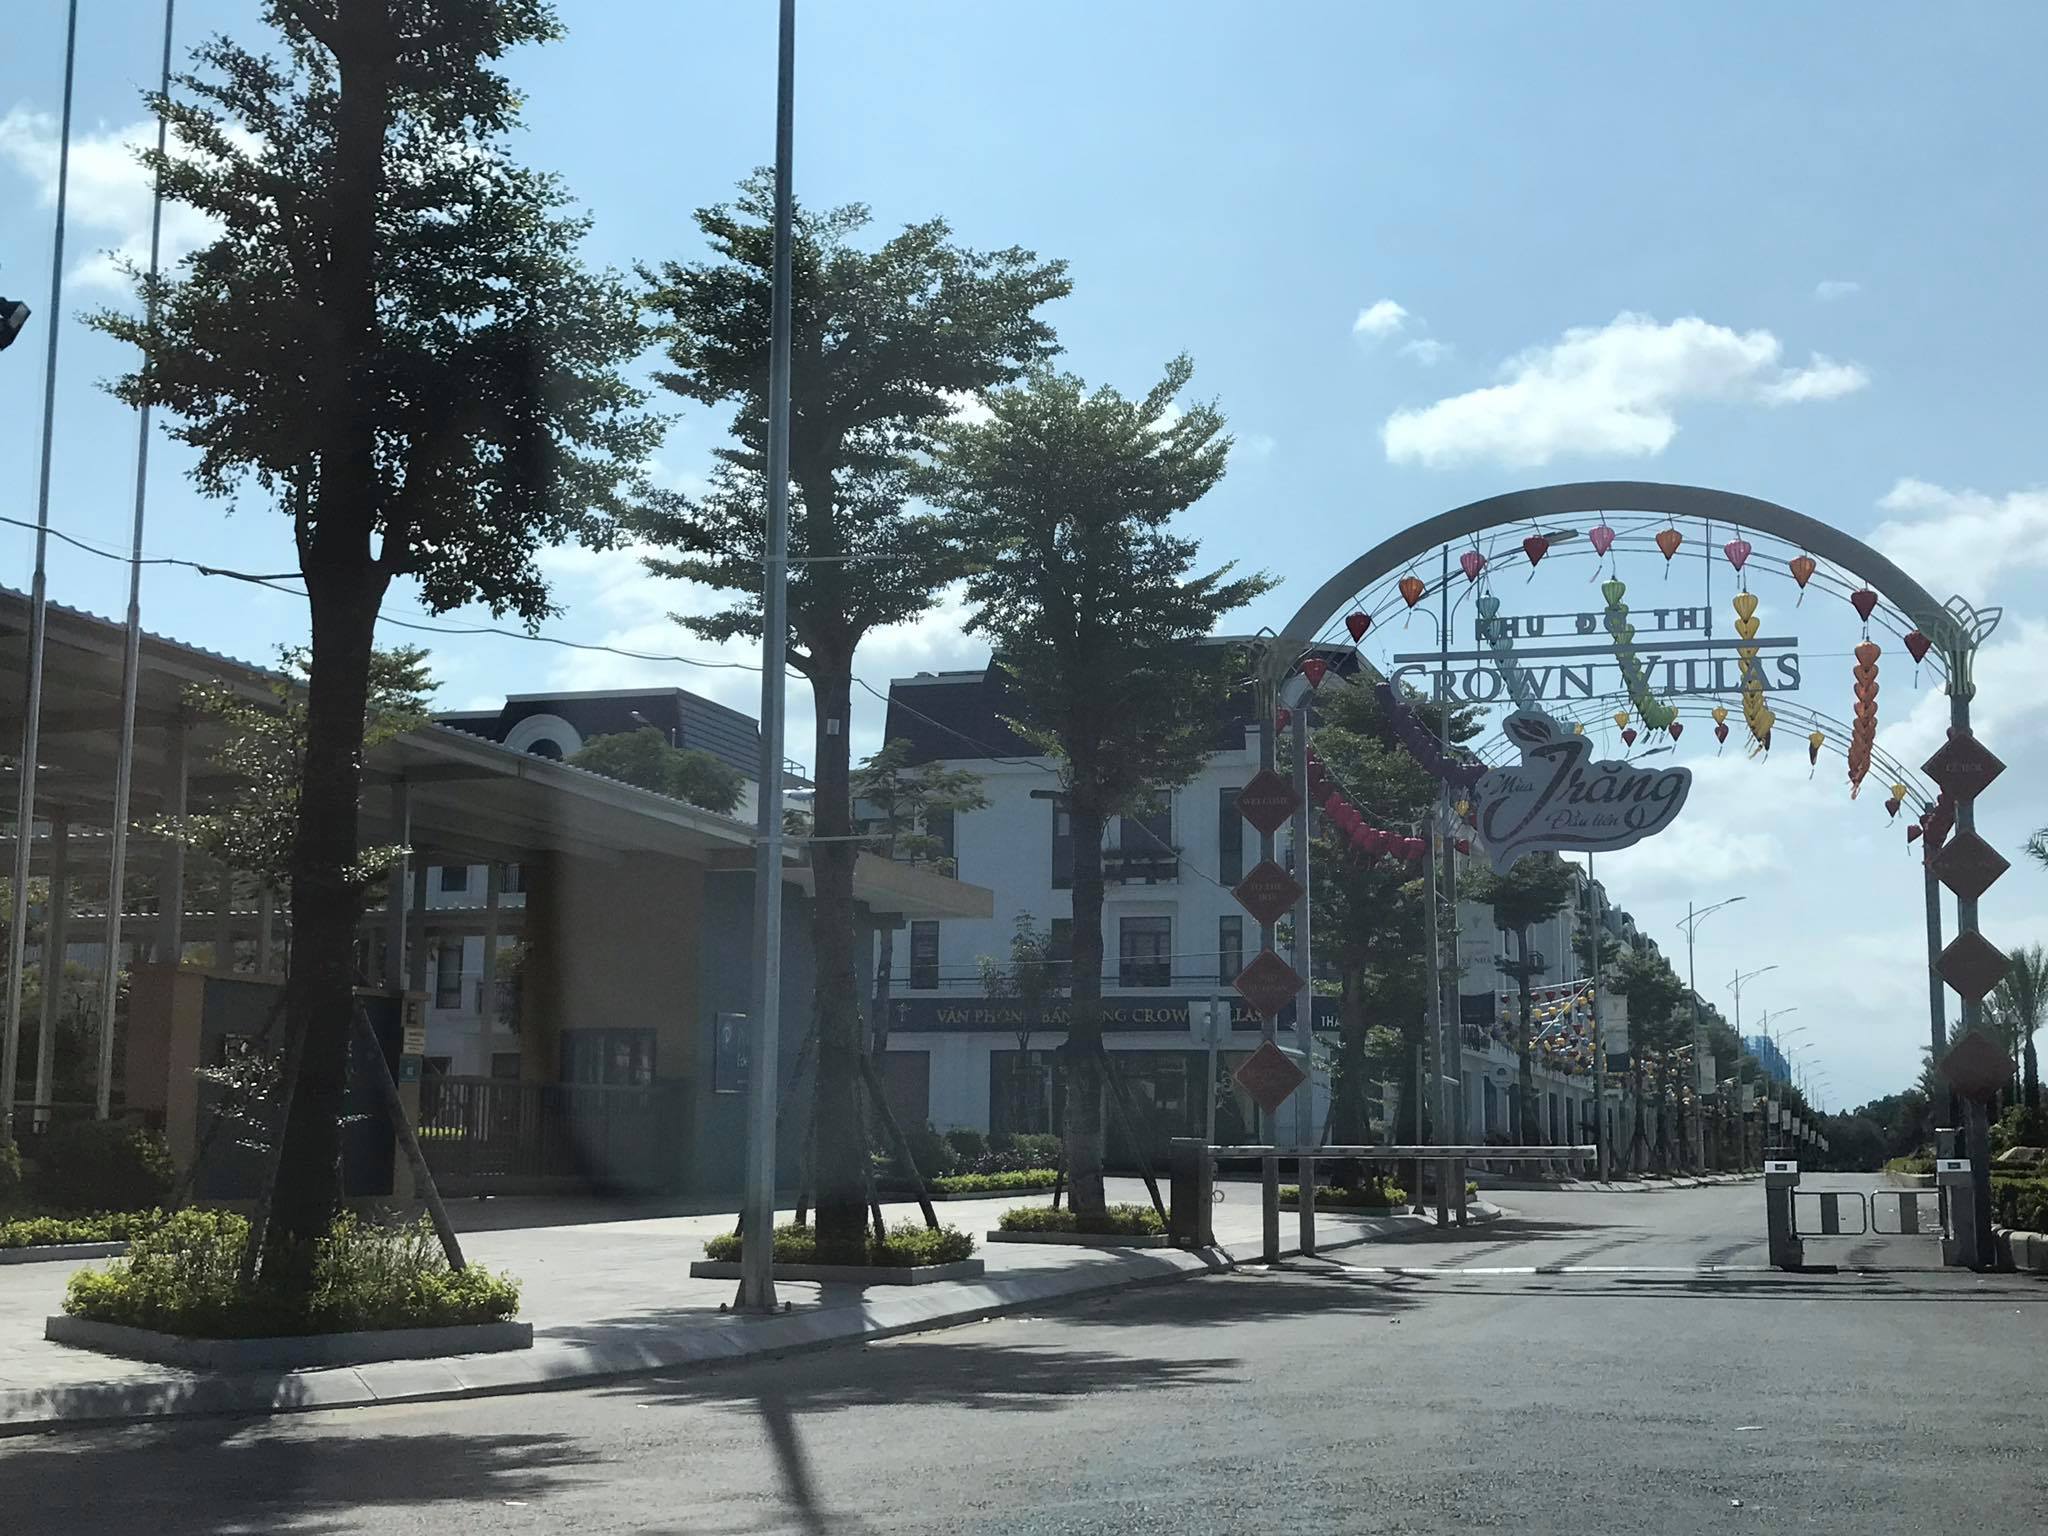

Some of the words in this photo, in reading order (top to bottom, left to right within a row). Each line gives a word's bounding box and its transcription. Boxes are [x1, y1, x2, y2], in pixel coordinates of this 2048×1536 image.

[1475, 615, 1544, 641] KHU
[1390, 663, 1598, 704] CROWN
[1483, 741, 1685, 844] Trăng
[936, 1006, 969, 1024] VĂN
[1131, 1008, 1190, 1023] CROW
